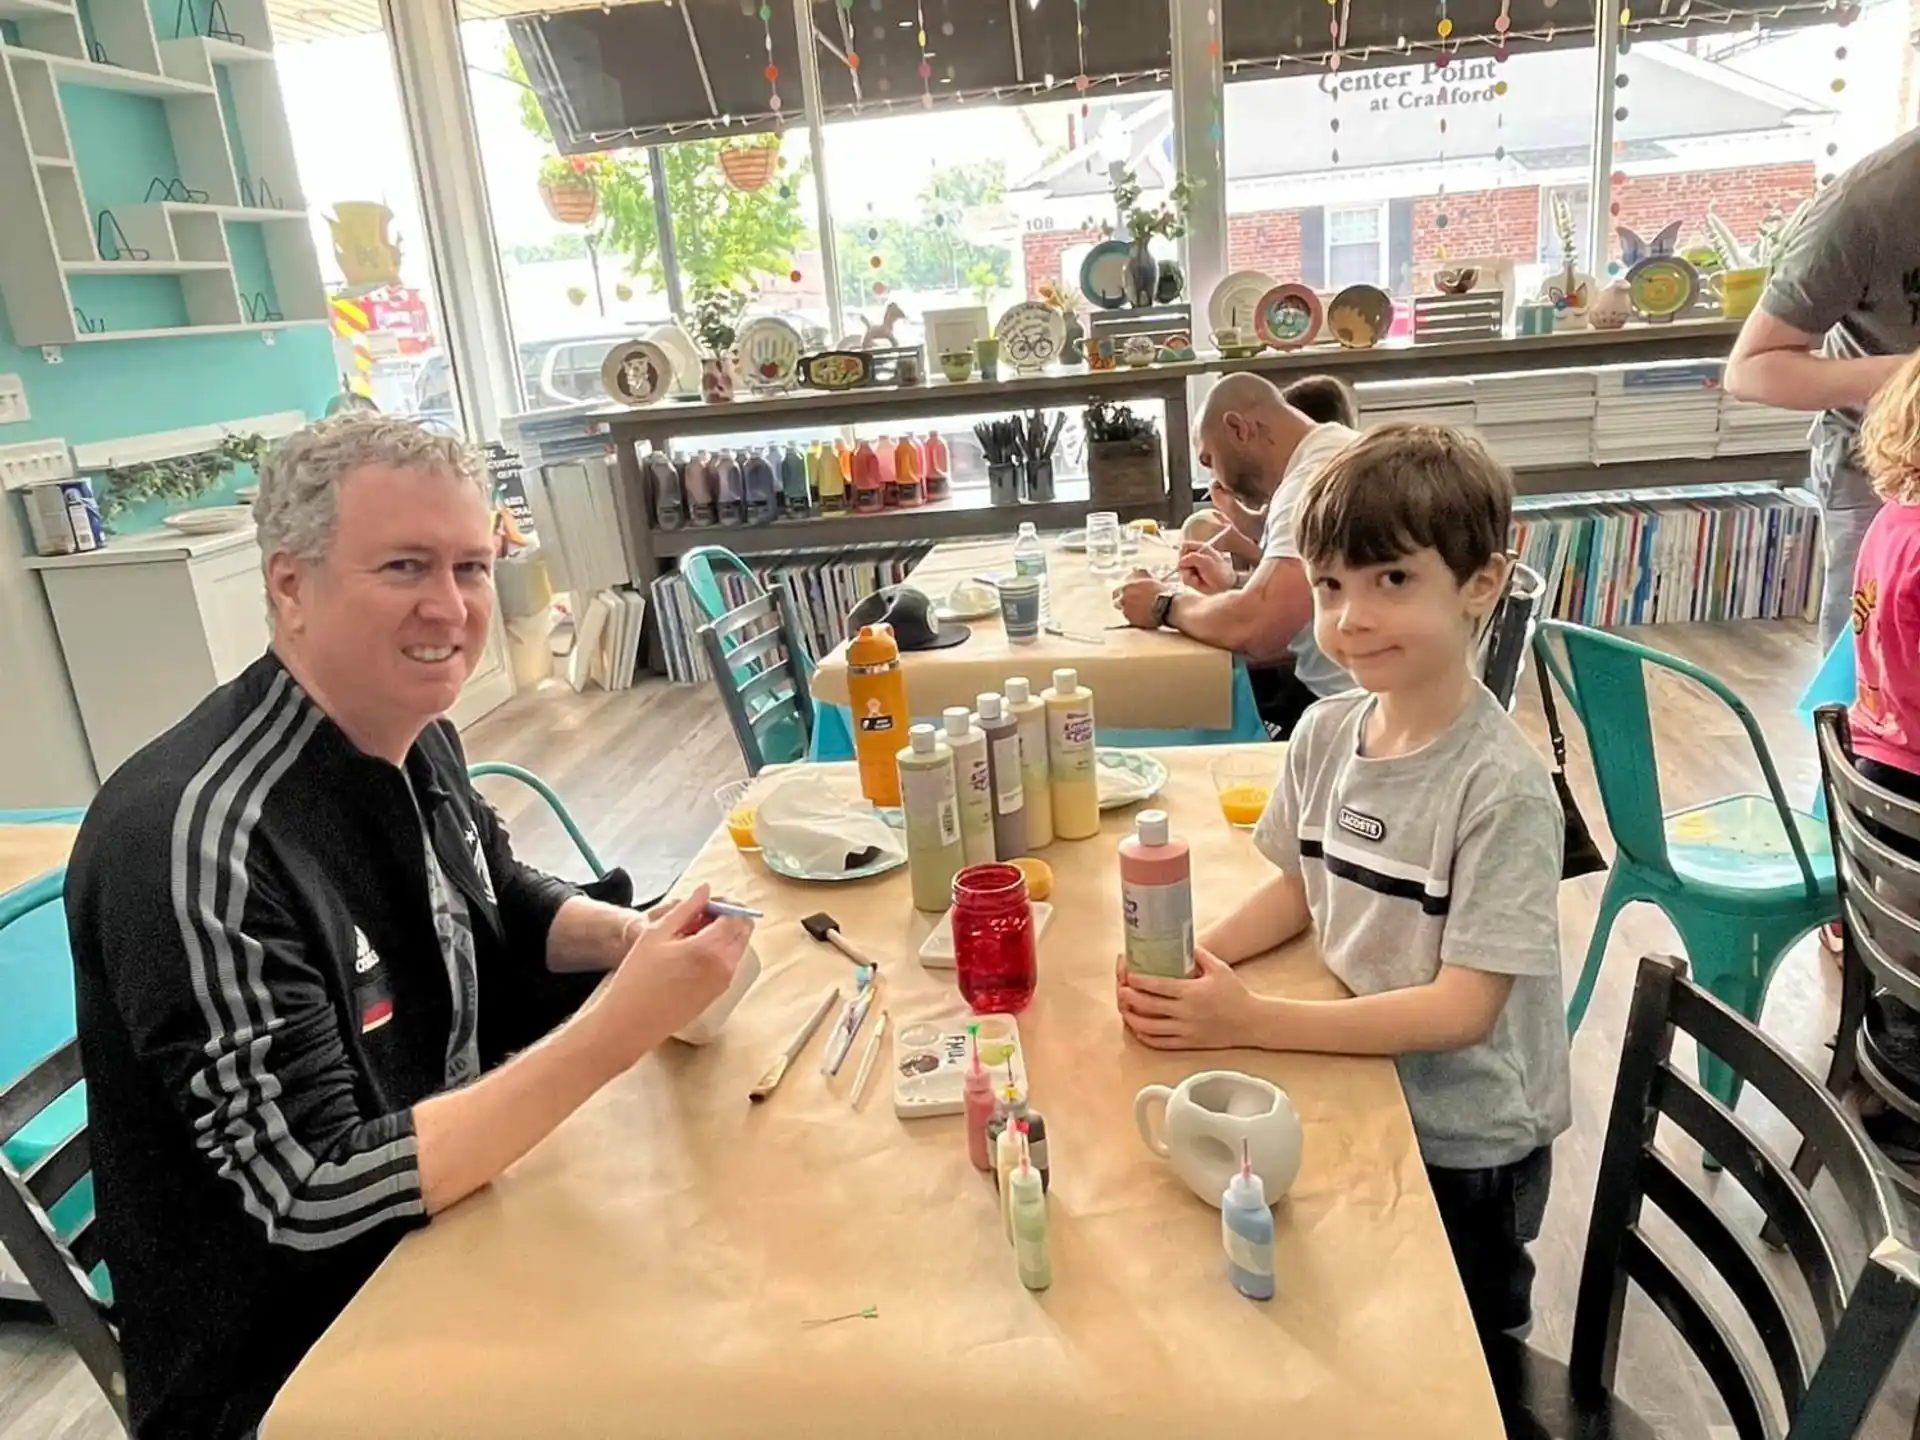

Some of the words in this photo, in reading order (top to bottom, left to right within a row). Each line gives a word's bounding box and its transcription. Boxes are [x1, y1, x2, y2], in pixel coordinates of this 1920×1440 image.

[1420, 59, 1497, 85] Point
[1369, 97, 1389, 112] at
[1026, 216, 1054, 231] 108
